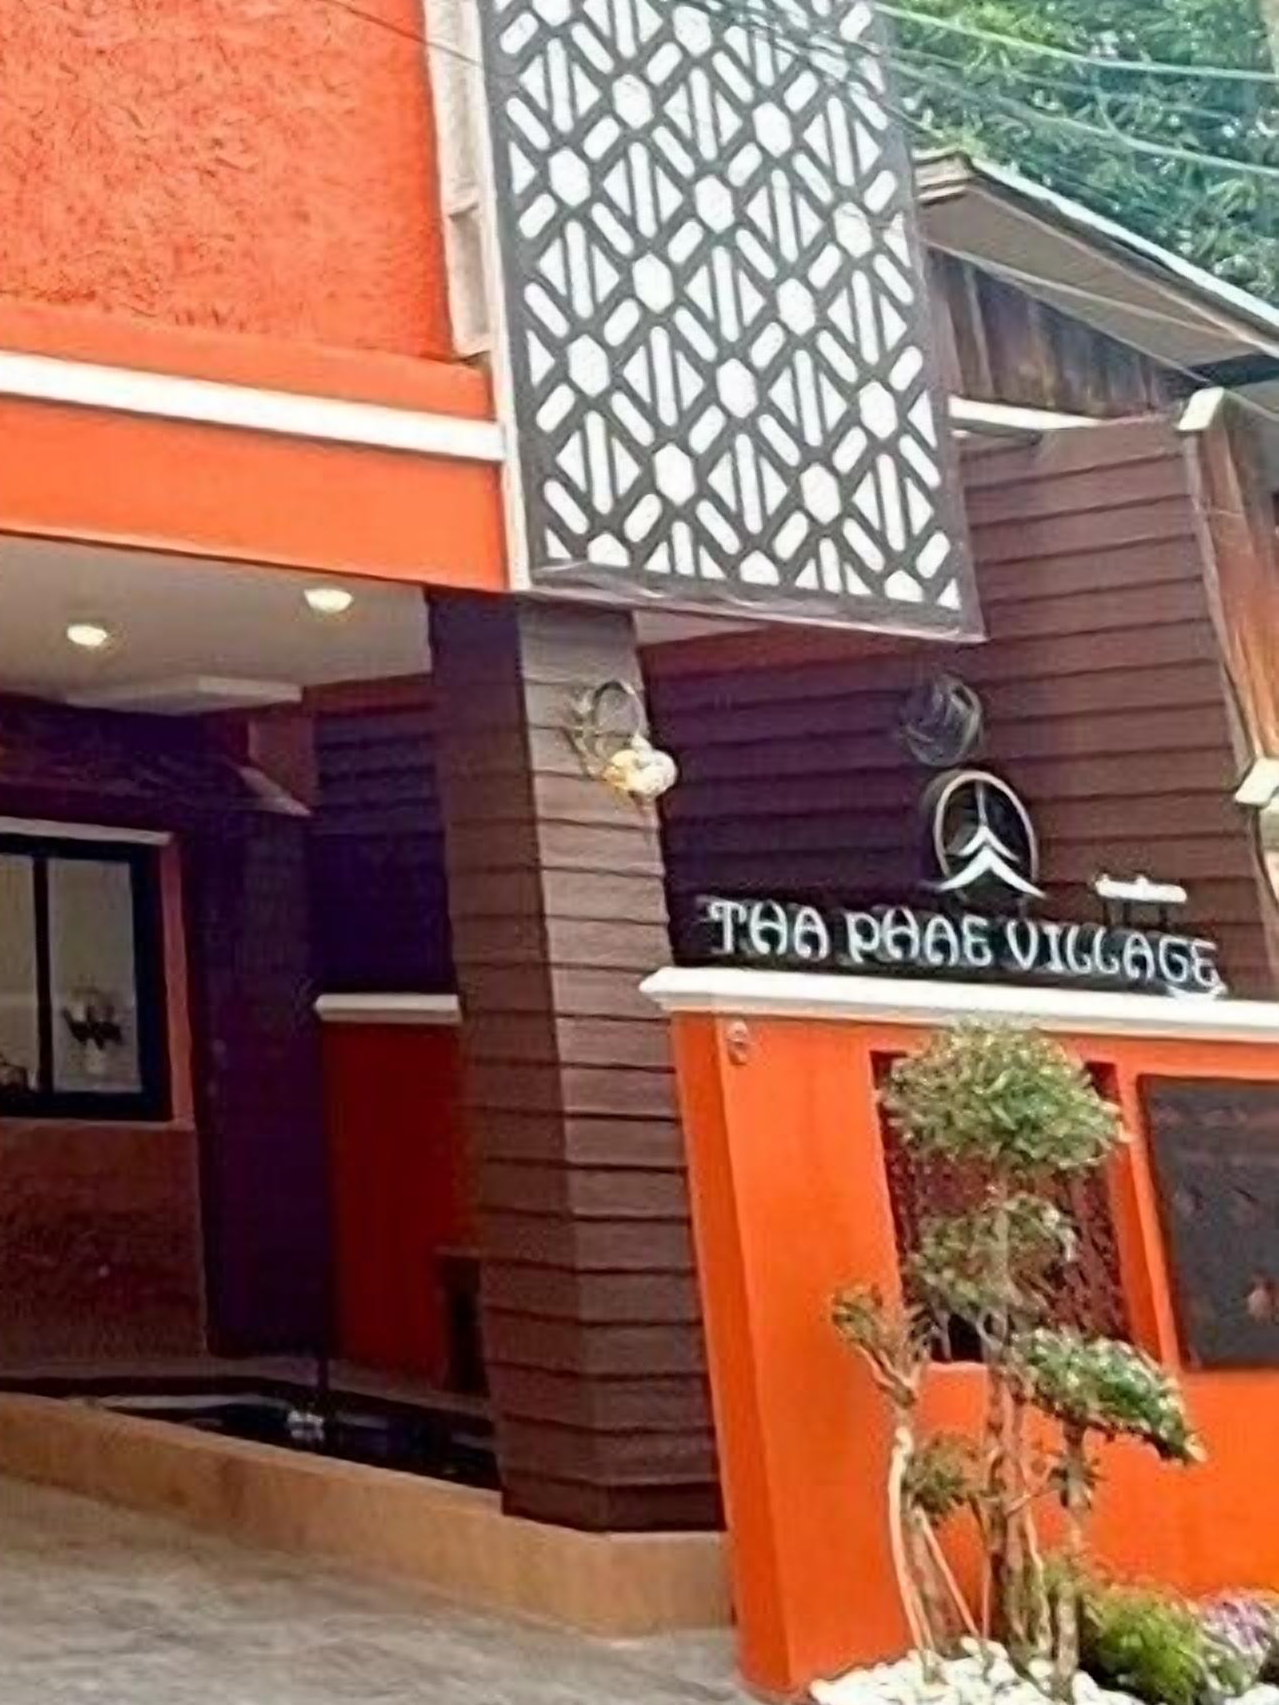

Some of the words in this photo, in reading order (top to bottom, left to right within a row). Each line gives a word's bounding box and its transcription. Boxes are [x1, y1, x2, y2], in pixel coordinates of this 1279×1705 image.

[709, 901, 830, 959] THA
[846, 905, 994, 966] PHAE
[1006, 919, 1220, 987] VILLAGE
